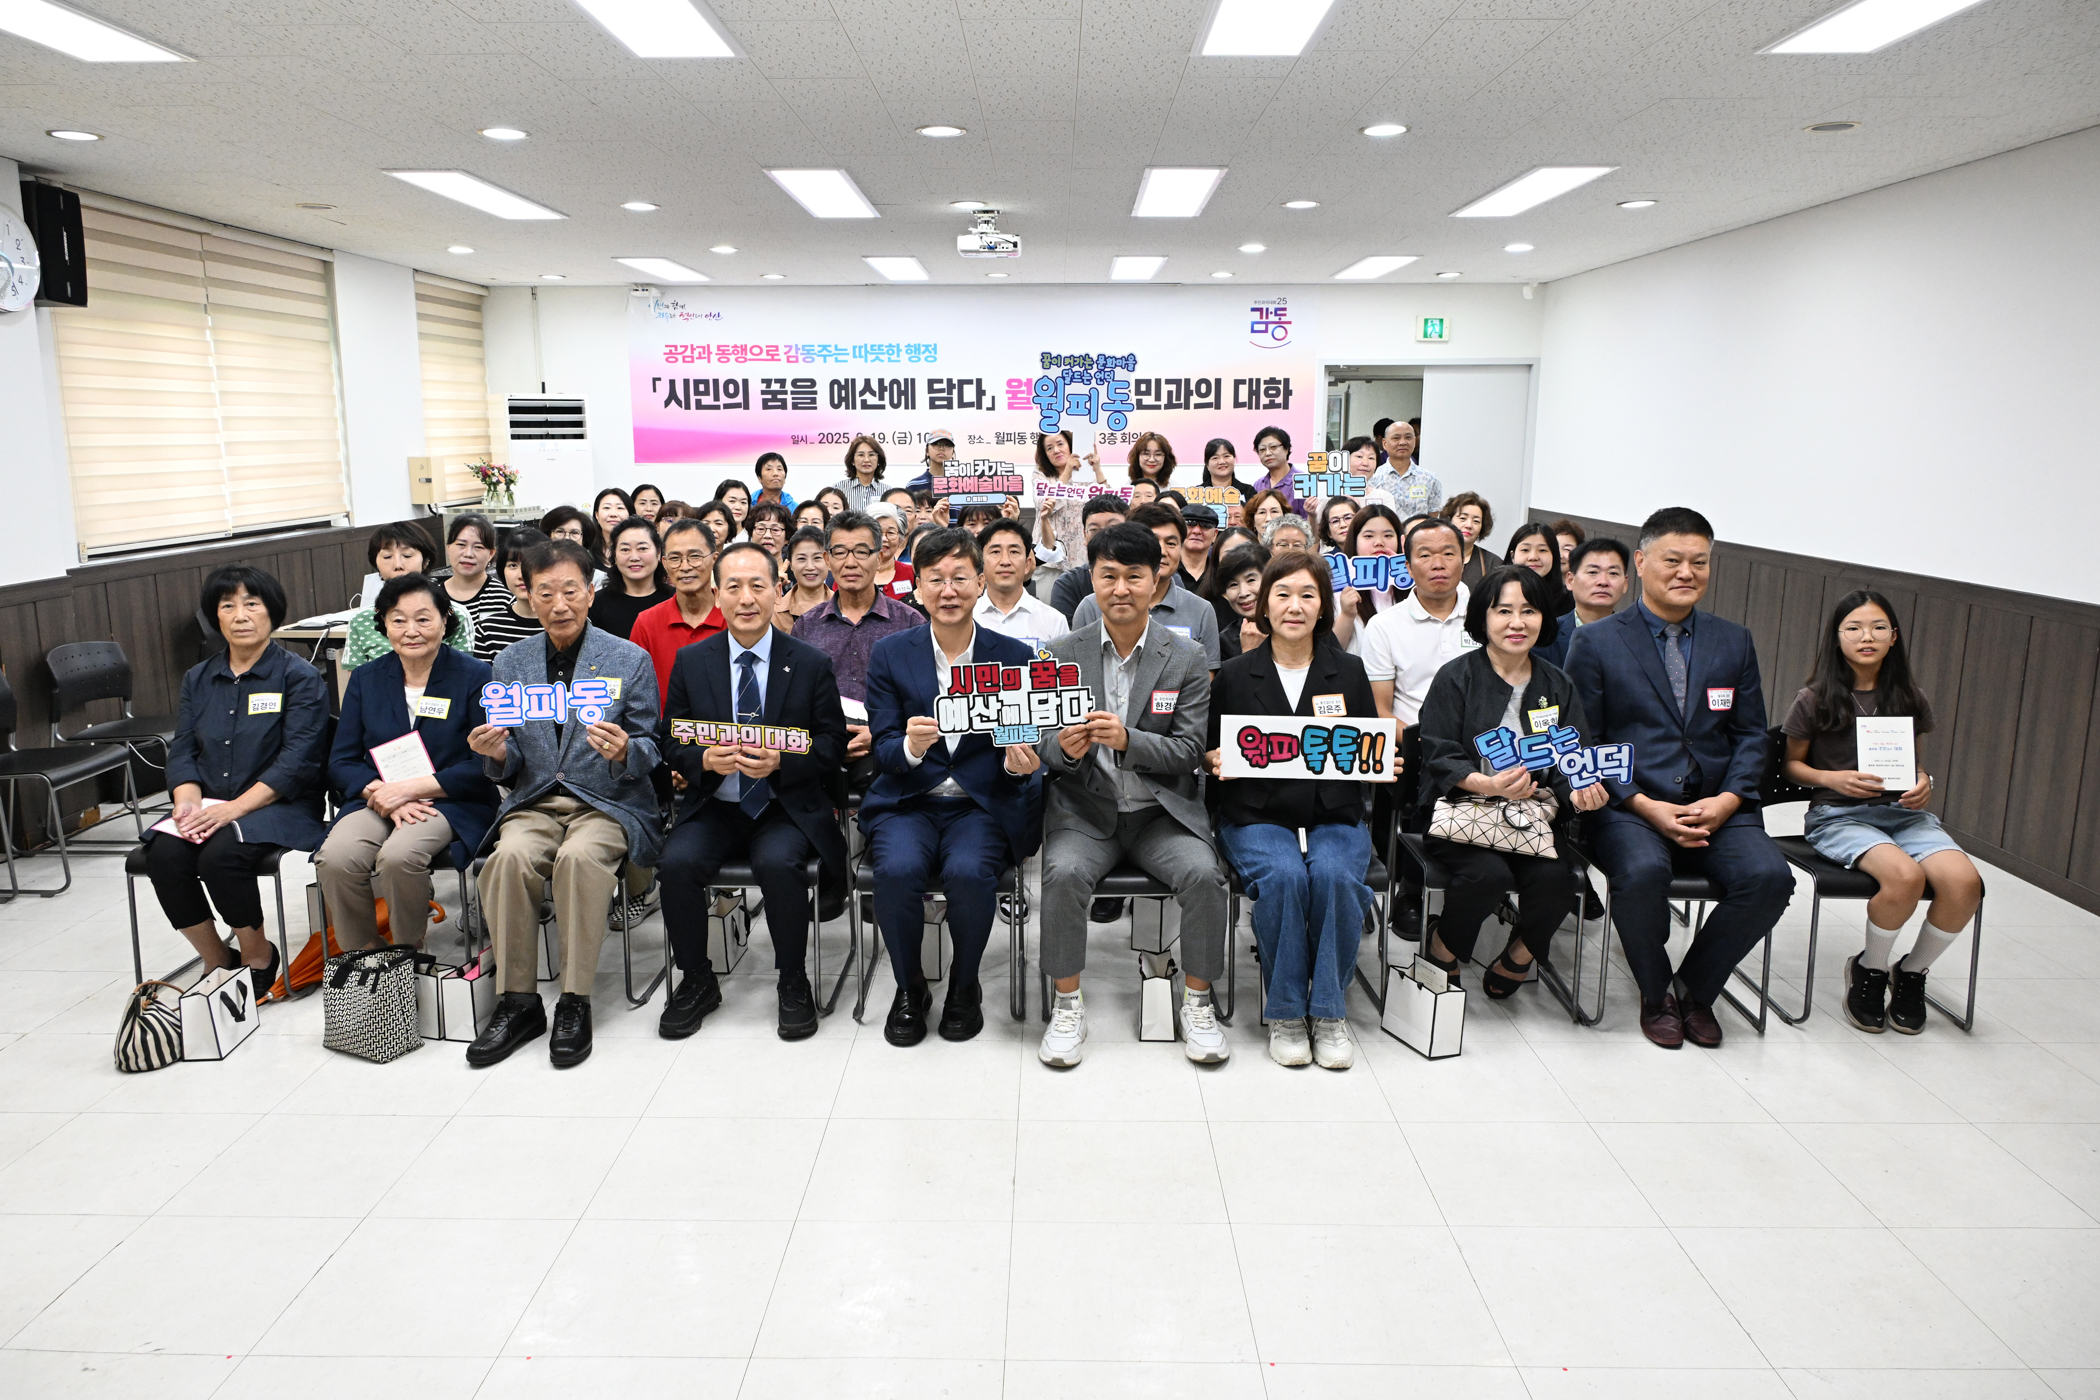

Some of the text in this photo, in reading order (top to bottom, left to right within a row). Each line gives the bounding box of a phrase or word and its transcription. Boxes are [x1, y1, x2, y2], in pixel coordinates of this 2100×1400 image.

[1277, 297, 1288, 305] 25
[705, 312, 723, 321] 안산
[1250, 307, 1292, 341] 감동
[663, 343, 938, 363] 공감과 동행으로 감동주는 따뜻한 행정
[1041, 352, 1062, 370] 꿈이
[1095, 353, 1137, 372] 문화마을
[1062, 368, 1116, 385] 달드는 언덕
[760, 377, 818, 411] 꿈을
[829, 377, 917, 411] 예산에
[1128, 377, 1222, 411] 민과의
[1233, 377, 1293, 411] 대화
[1032, 375, 1135, 434] 월피동
[892, 431, 913, 446] (금)
[994, 432, 1028, 445] 월피동
[1098, 432, 1118, 446] 3층
[943, 459, 1015, 477] 꿈이 커가는
[1307, 451, 1349, 474] 꿈이
[932, 474, 1024, 495] 문화예술마을
[1293, 473, 1367, 498] 커가는
[947, 660, 1080, 696] 시민의 꿈을
[481, 680, 615, 727] 월피동
[936, 687, 1095, 734] 예산에 담다
[1318, 704, 1342, 714] 김은주
[992, 724, 1040, 746] 월피동
[1236, 725, 1300, 769] 월피
[1473, 726, 1635, 791] 달드는 언덕
